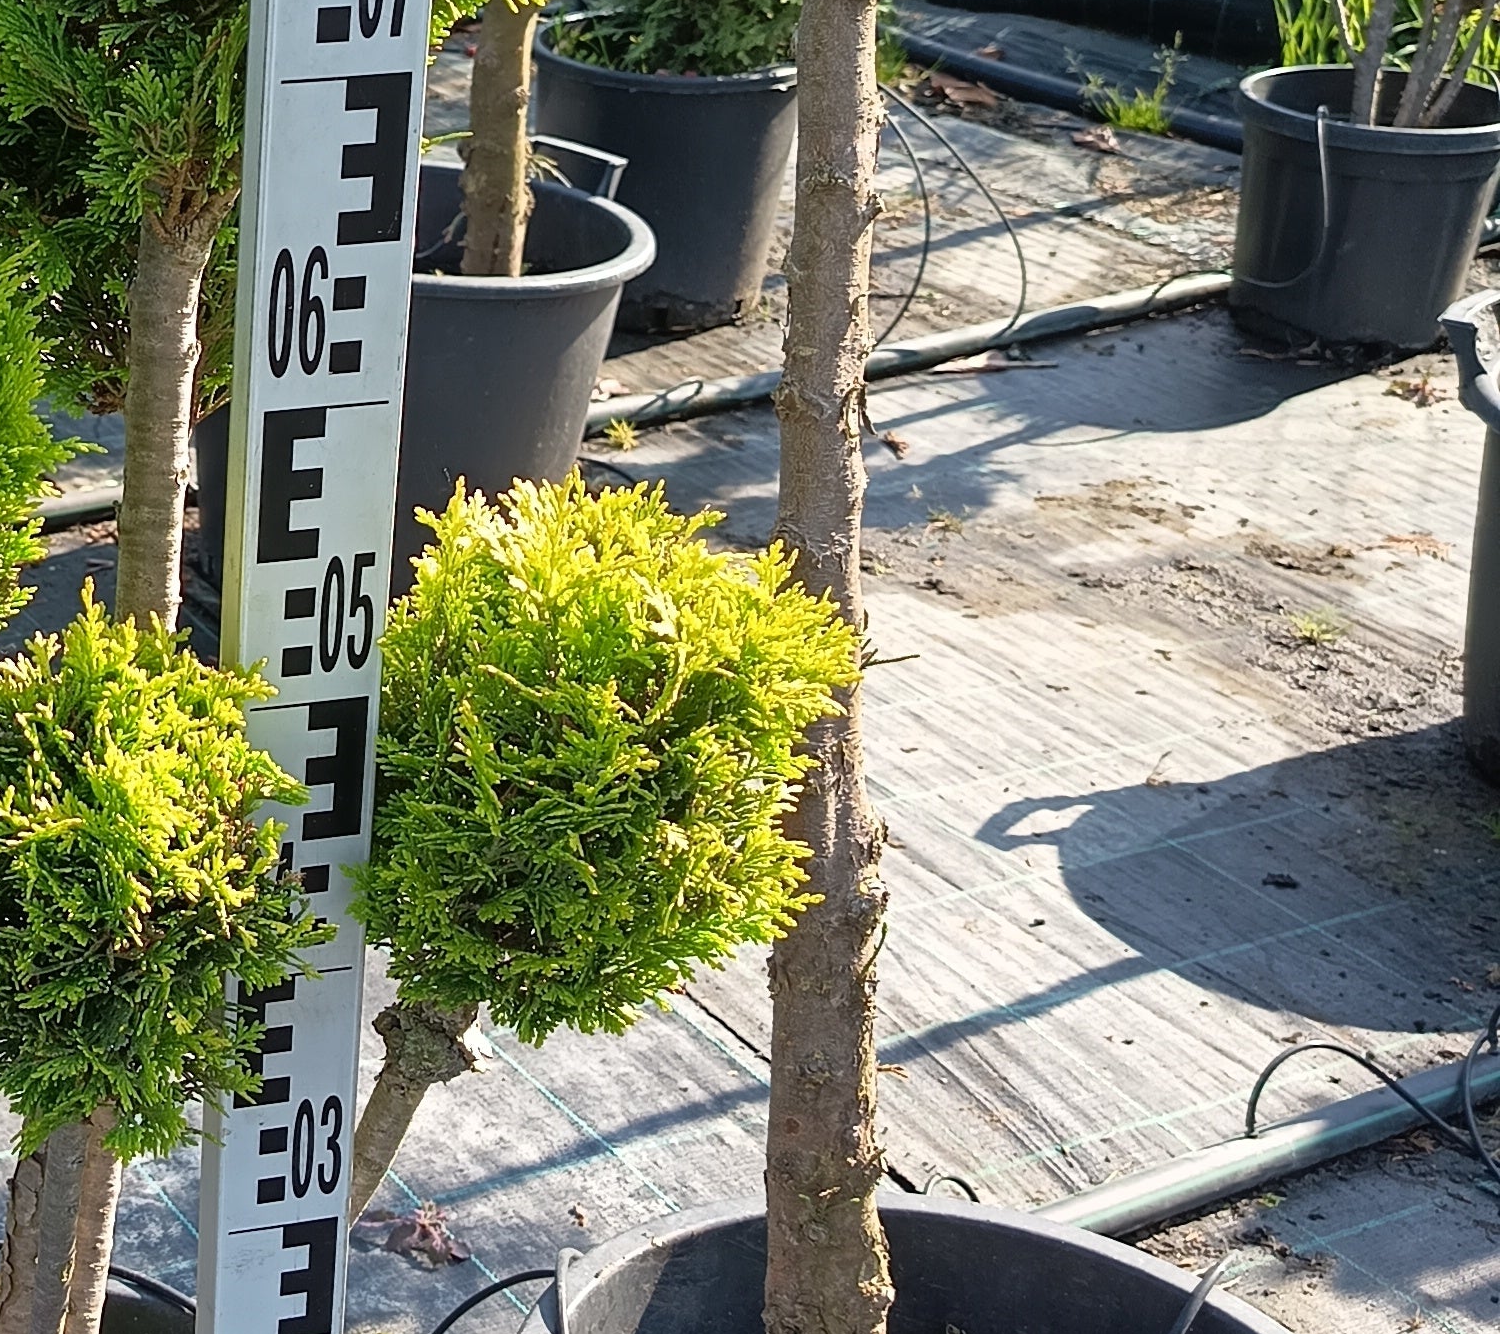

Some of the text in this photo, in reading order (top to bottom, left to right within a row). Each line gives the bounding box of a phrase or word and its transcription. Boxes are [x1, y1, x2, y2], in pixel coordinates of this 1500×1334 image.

[267, 244, 329, 379] 06
[318, 551, 376, 674] 05
[291, 1093, 344, 1200] 03
